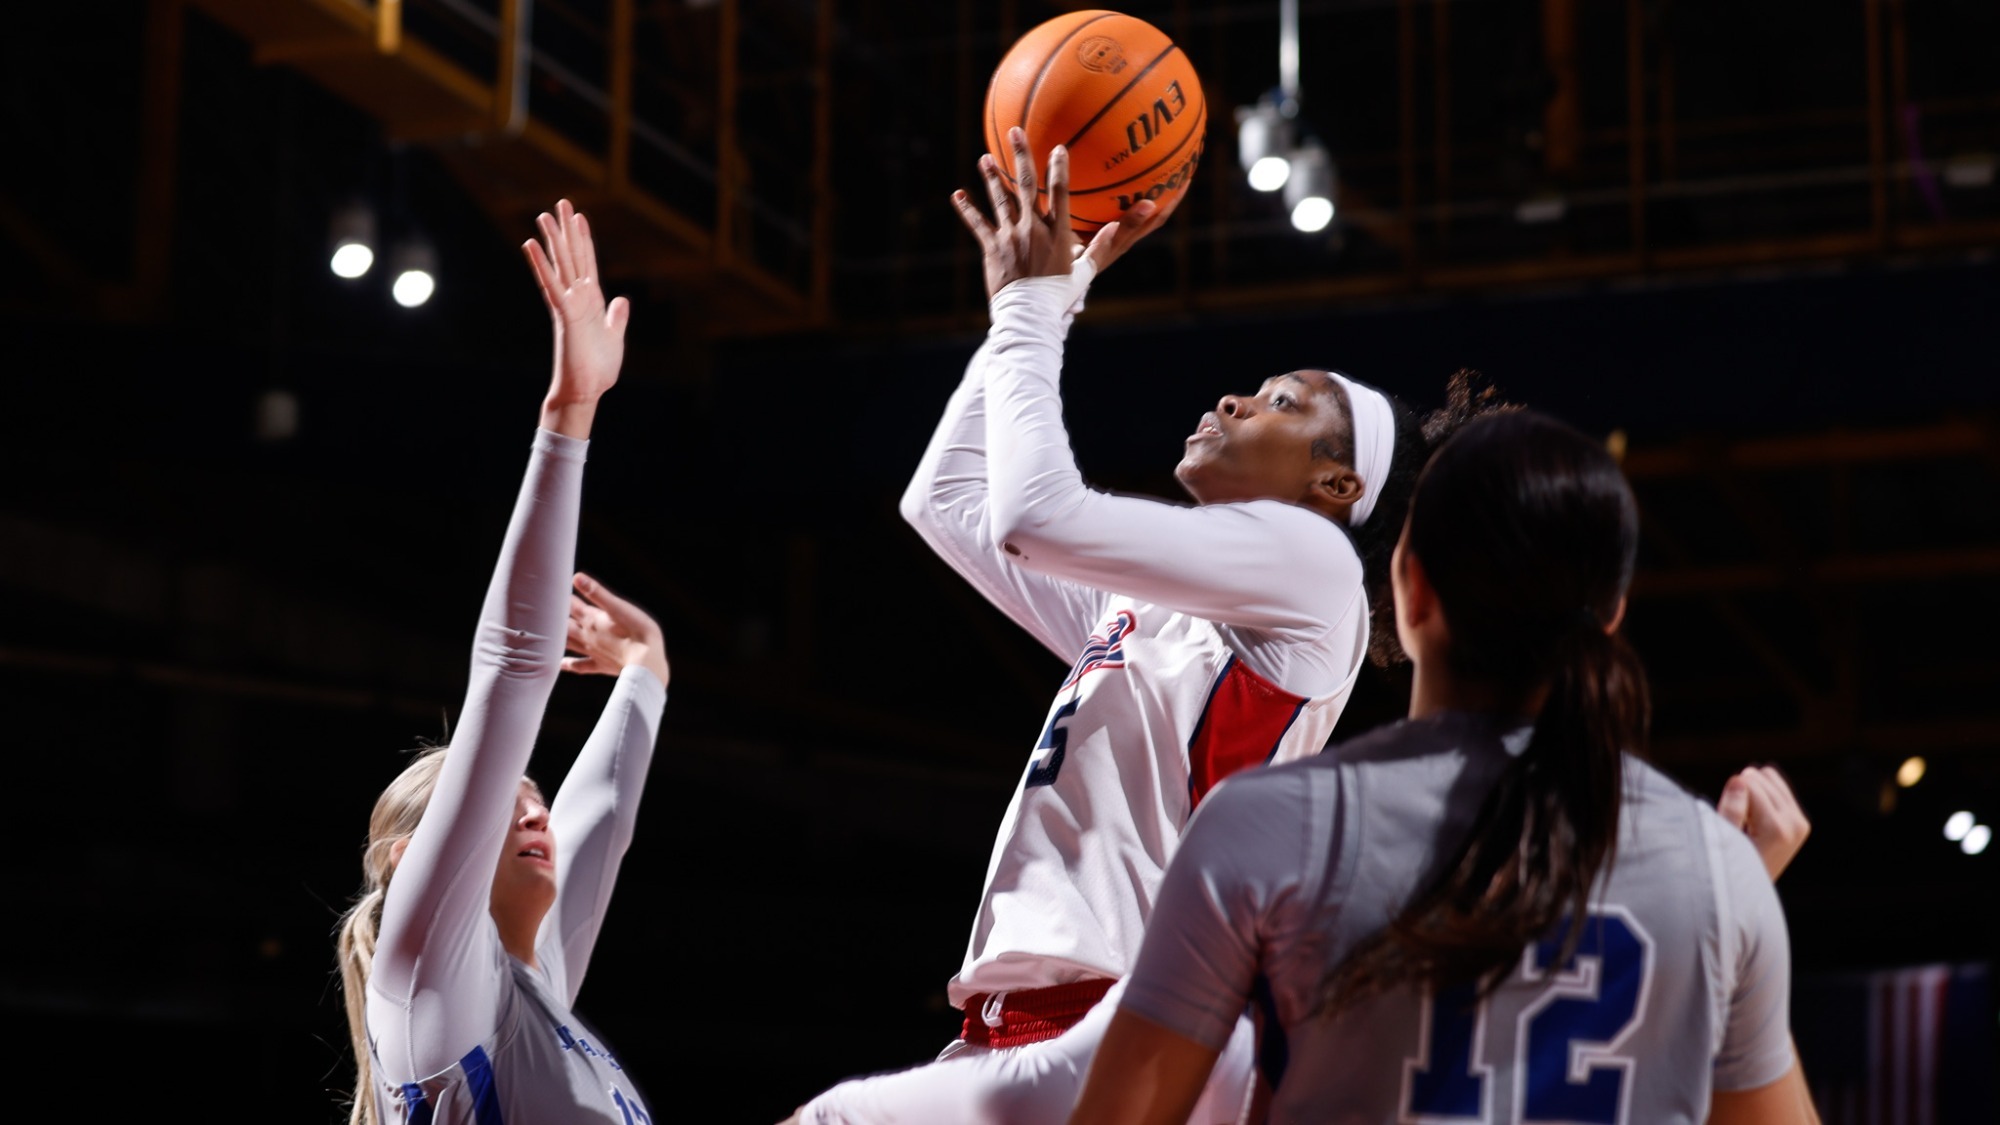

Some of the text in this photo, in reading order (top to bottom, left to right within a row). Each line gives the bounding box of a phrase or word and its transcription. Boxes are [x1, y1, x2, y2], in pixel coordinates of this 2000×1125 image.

[1126, 80, 1187, 154] EVO
[1024, 694, 1083, 789] 5
[1399, 903, 1656, 1125] 12
